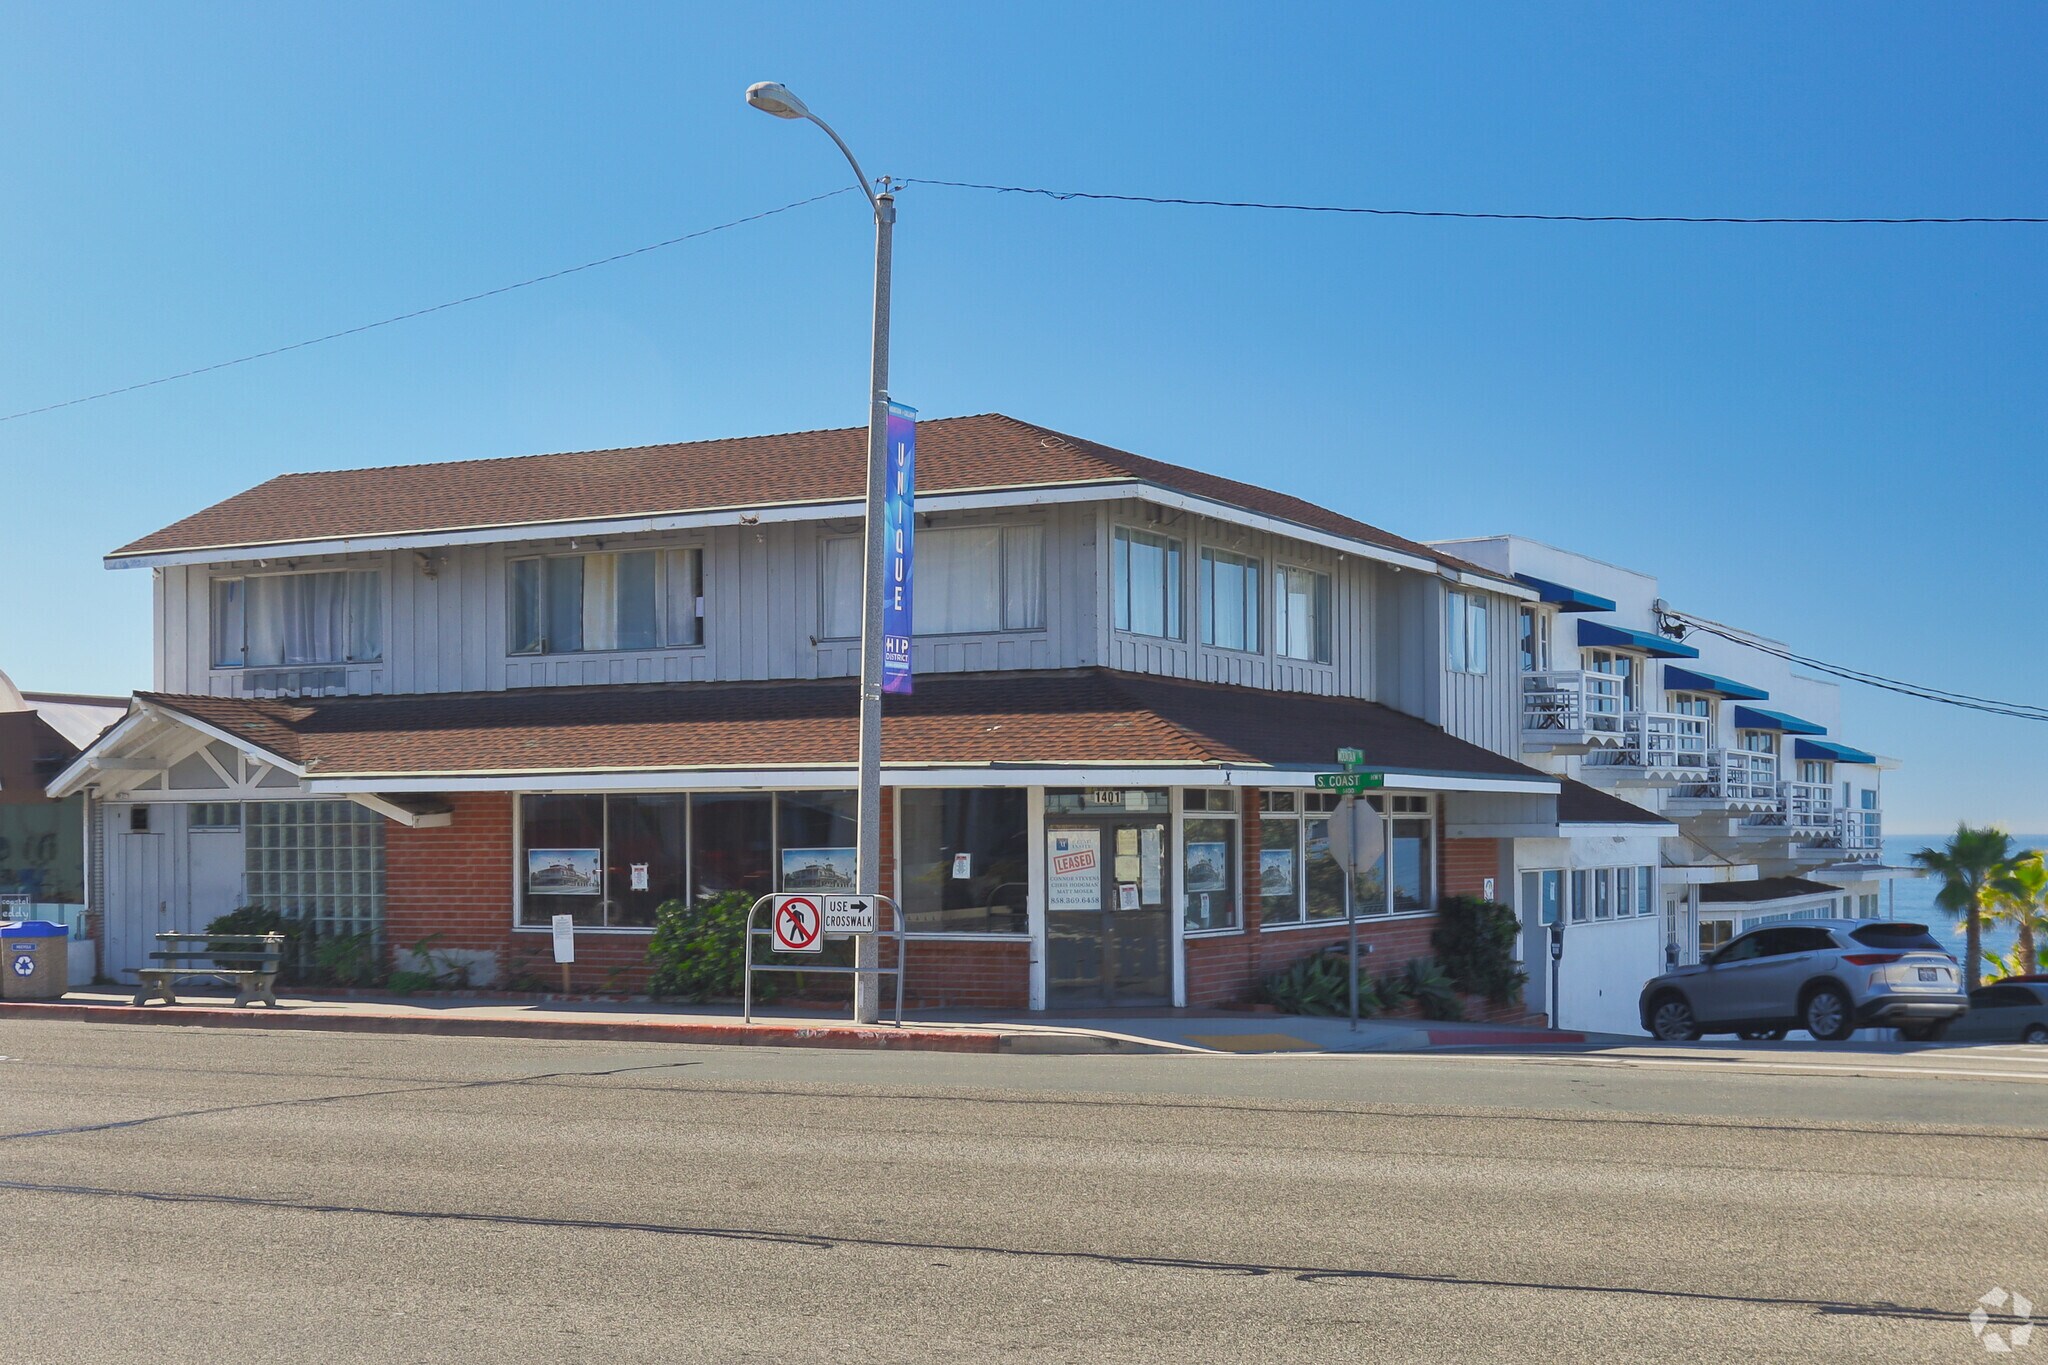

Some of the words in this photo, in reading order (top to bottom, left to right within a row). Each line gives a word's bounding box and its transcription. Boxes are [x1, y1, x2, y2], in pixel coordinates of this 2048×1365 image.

[895, 442, 905, 611] UNIQUE
[886, 637, 909, 653] HIP
[885, 652, 909, 662] DISTRICT
[1317, 775, 1325, 787] S.
[1329, 774, 1360, 787] COAST
[1096, 791, 1120, 803] 1401
[1057, 853, 1092, 871] LEASED
[2, 905, 29, 920] eddy
[830, 901, 848, 912] USE
[825, 915, 872, 927] CROSSWALK
